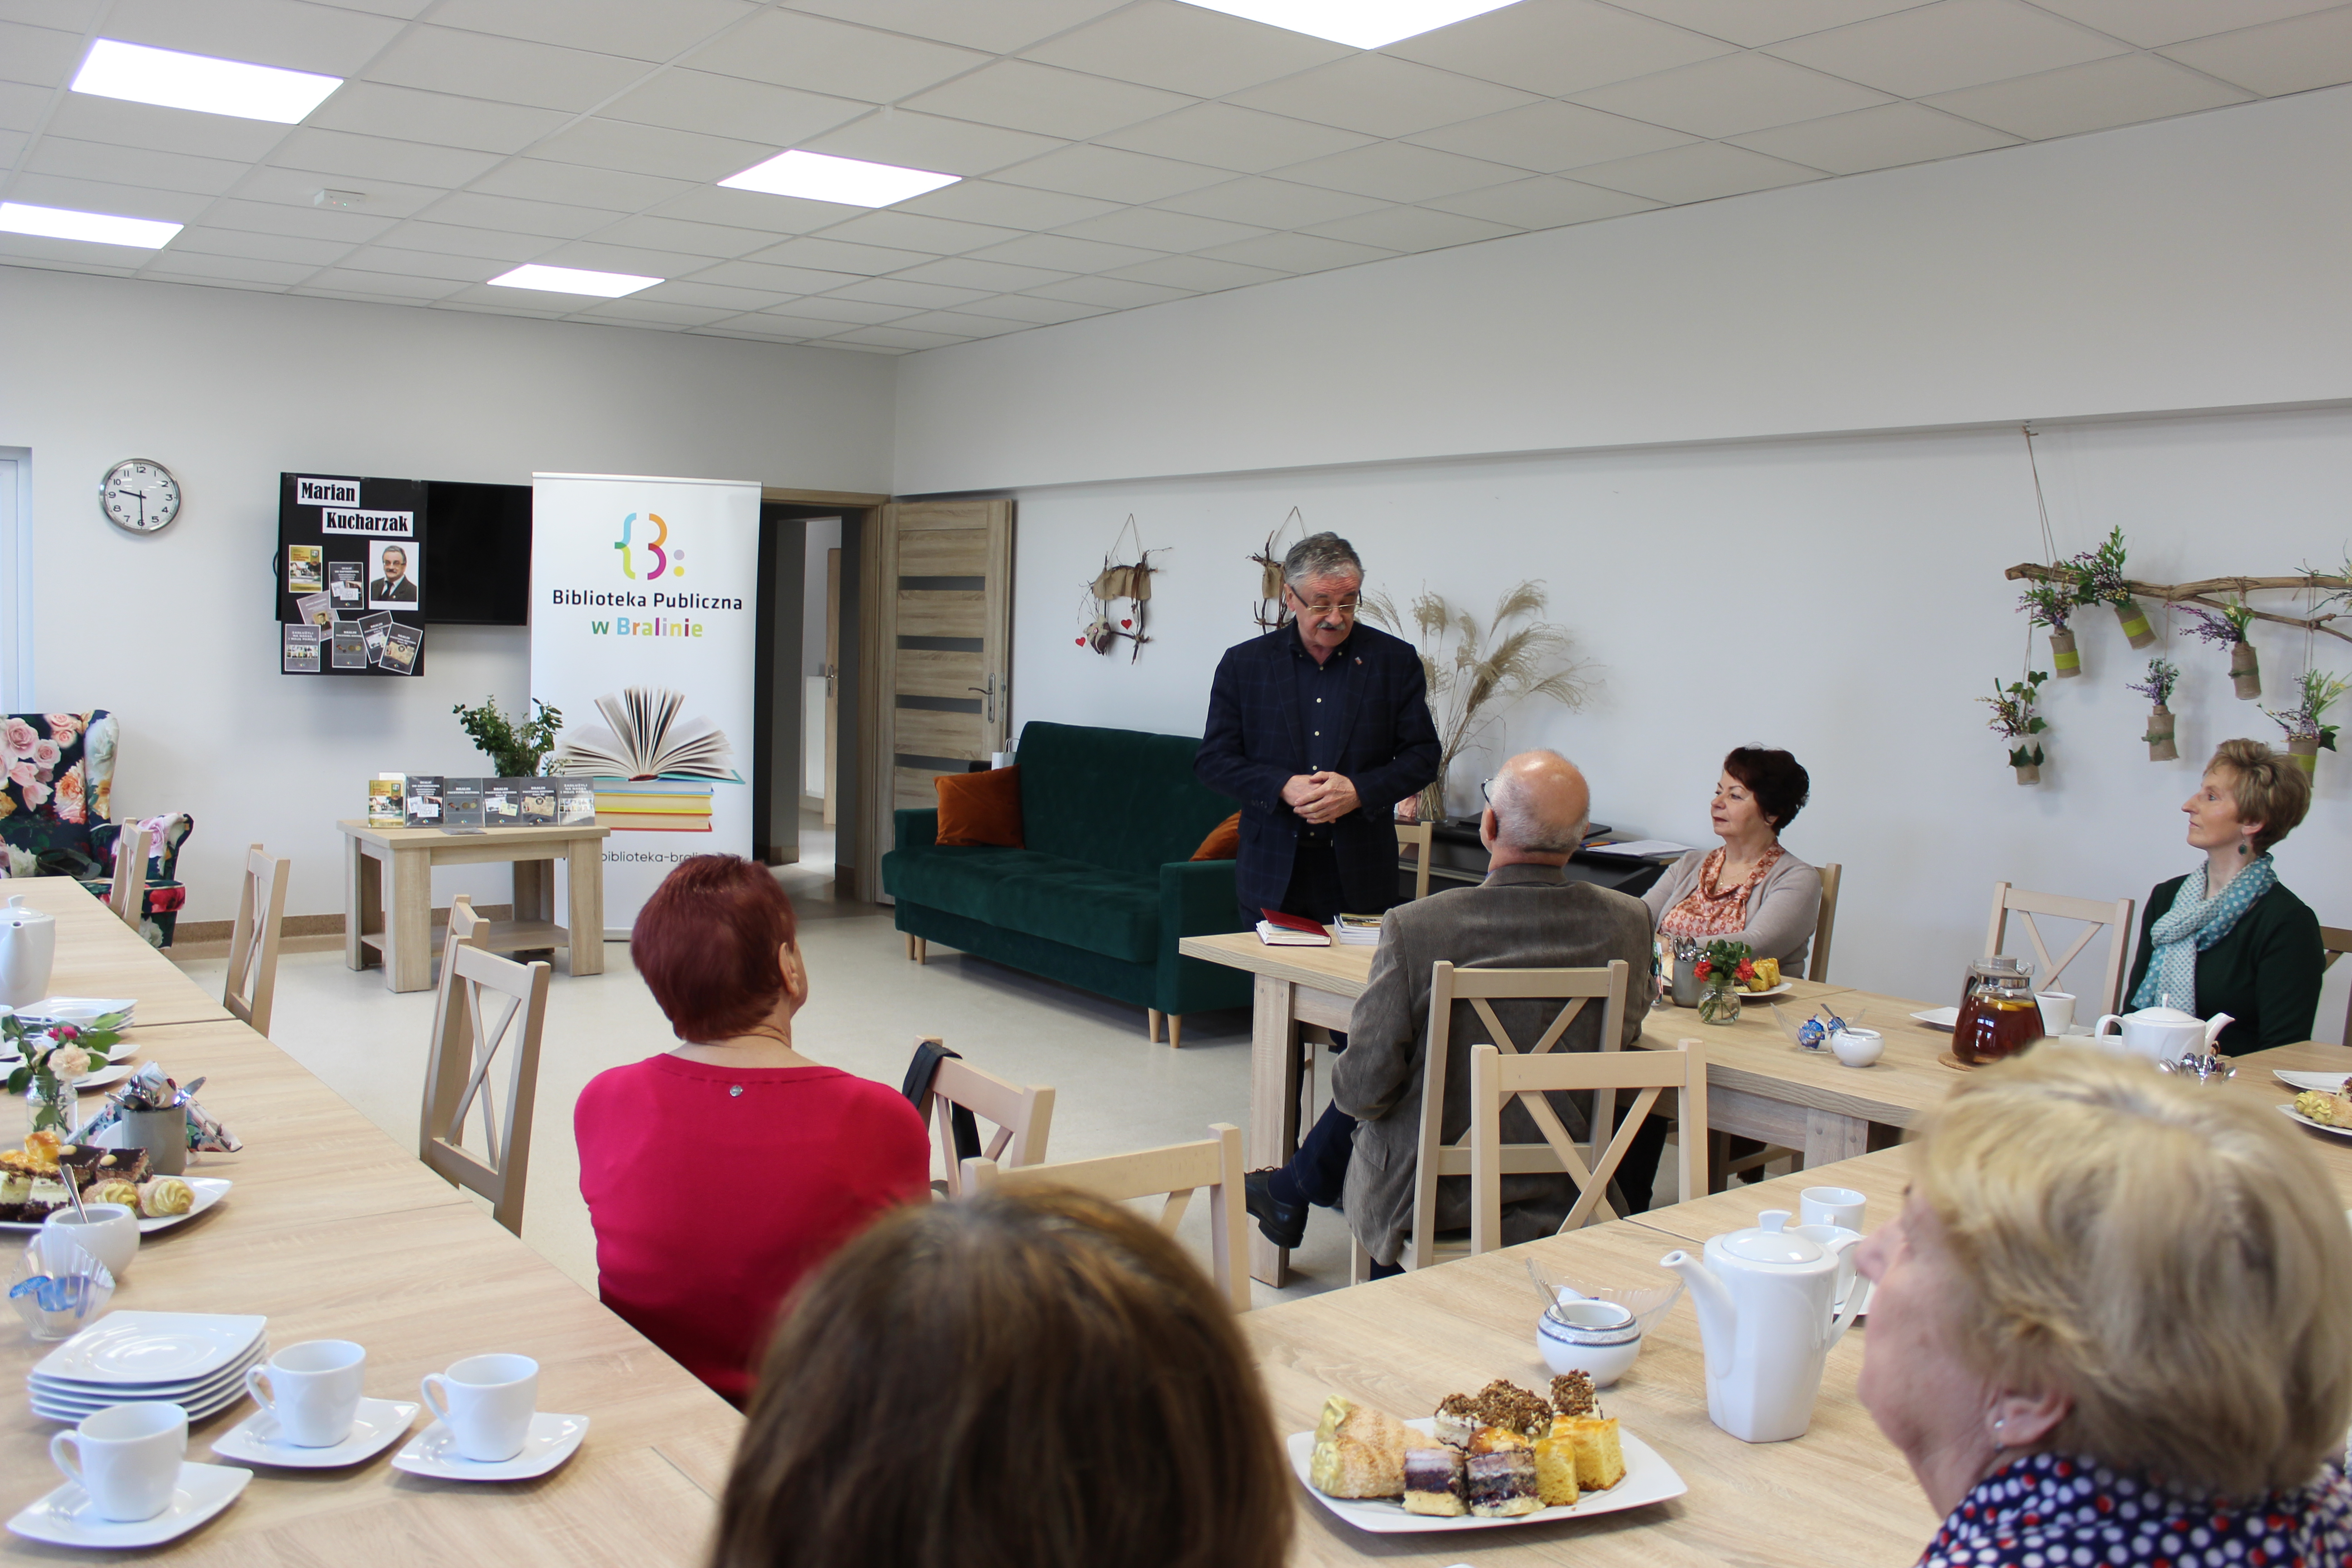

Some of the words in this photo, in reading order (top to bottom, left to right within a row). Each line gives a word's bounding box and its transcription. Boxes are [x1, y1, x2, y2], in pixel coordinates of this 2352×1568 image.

[301, 482, 355, 502] Marian
[326, 511, 409, 531] Kucharzak
[553, 589, 647, 607] Biblioteka
[653, 592, 743, 610] Publiczna
[592, 621, 610, 635] w
[617, 617, 703, 637] Bralinie
